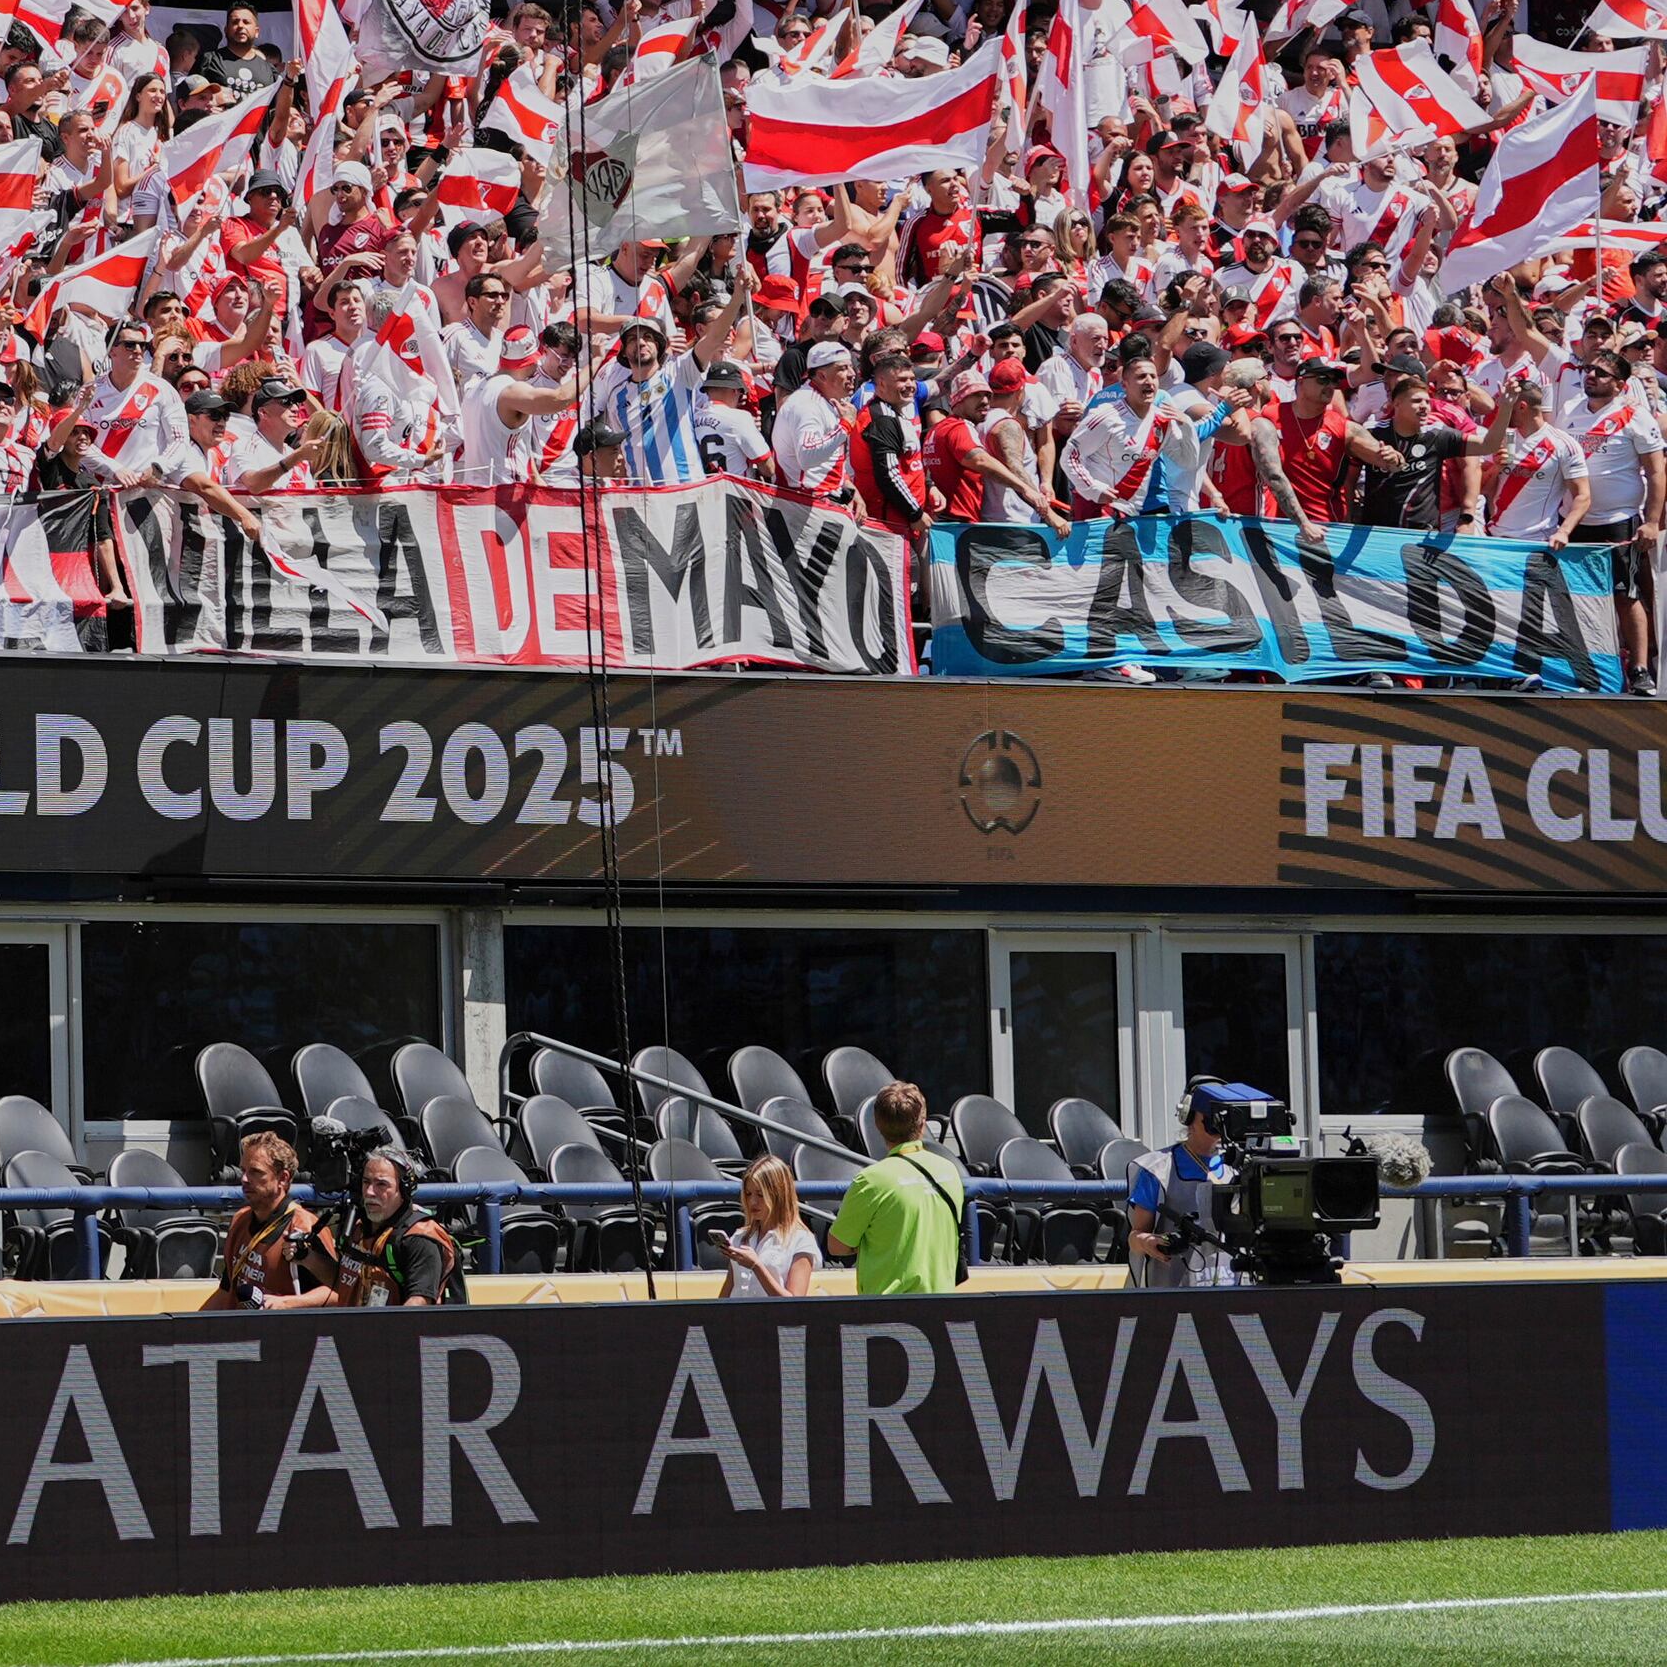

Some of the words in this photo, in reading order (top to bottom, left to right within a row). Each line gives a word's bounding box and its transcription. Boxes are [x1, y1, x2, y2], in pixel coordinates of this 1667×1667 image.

[94, 418, 149, 432] codere
[124, 492, 447, 656] VILLA
[454, 500, 600, 652] DE
[610, 495, 899, 675] MAYO
[955, 518, 1602, 692] CASILDA
[136, 713, 351, 822] CUP
[1300, 741, 1505, 839] FIFA
[630, 1306, 1438, 1516] AIRWAYS
